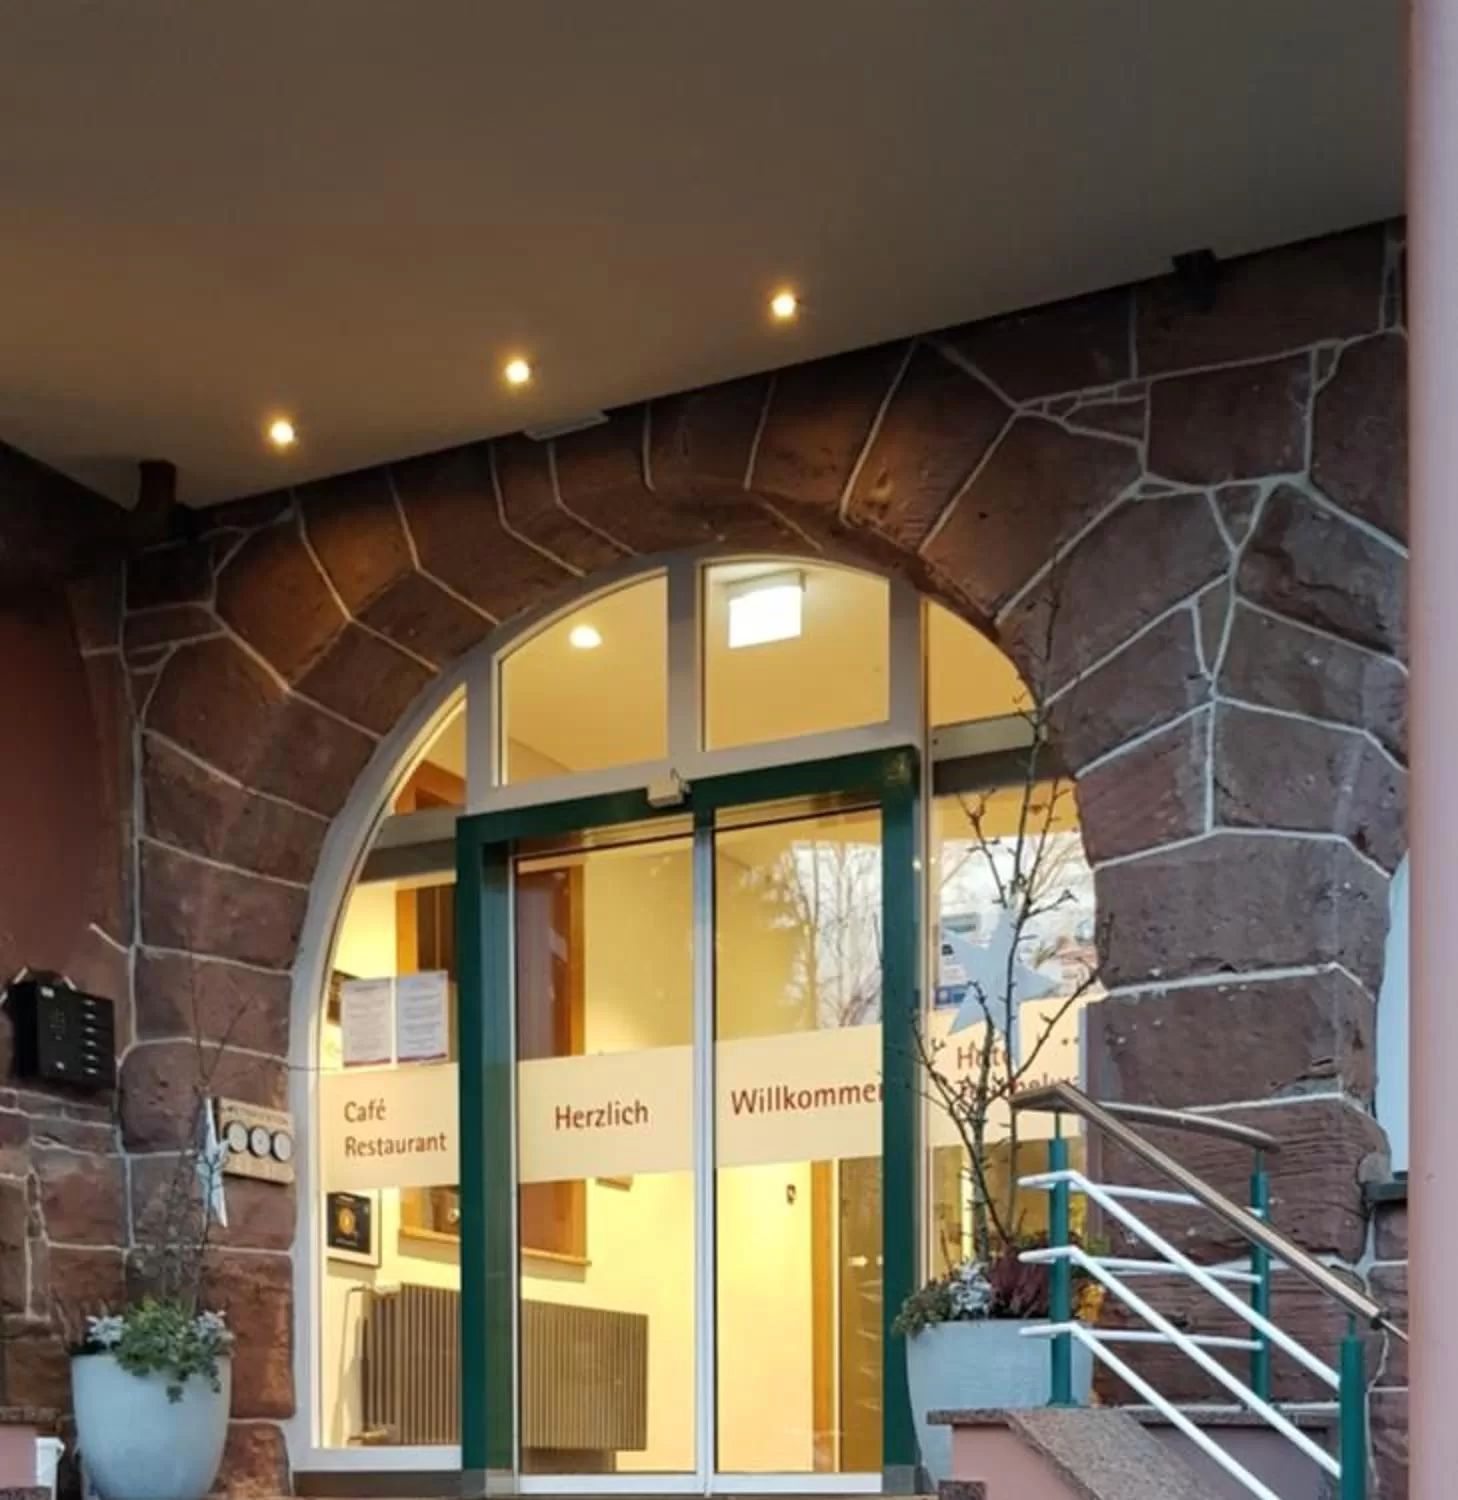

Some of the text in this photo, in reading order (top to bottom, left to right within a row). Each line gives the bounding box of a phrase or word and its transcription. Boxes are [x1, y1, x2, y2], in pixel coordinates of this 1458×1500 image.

[343, 1098, 387, 1124] Café
[554, 1099, 649, 1131] Herzlich
[344, 1131, 448, 1158] Restaurant
